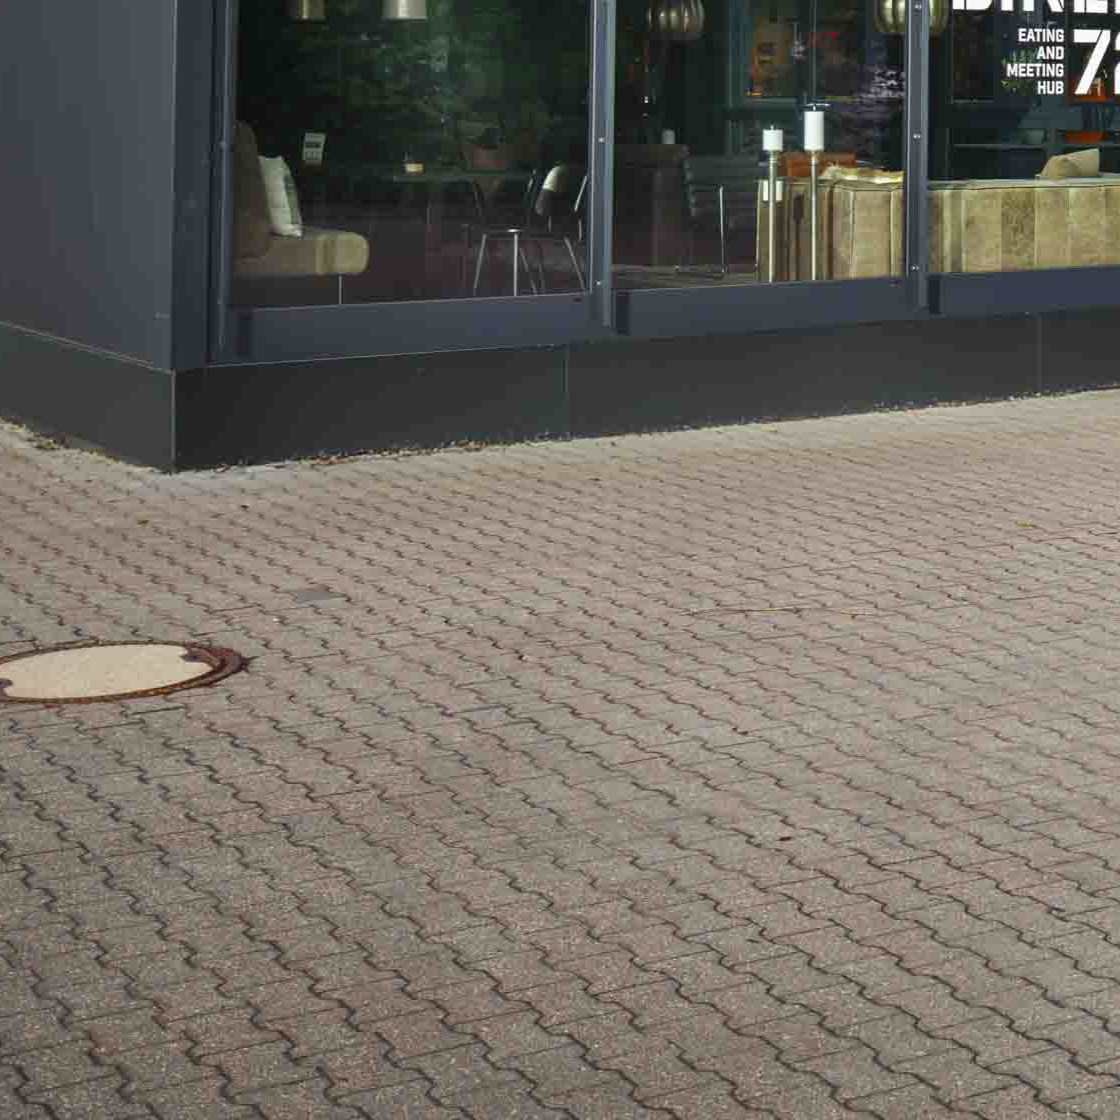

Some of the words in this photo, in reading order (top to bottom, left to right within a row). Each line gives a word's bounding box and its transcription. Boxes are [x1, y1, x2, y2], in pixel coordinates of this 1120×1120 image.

[1018, 28, 1064, 43] EATING
[1036, 45, 1064, 60] AND
[1006, 63, 1064, 78] MEETING
[1037, 81, 1064, 95] HUB
